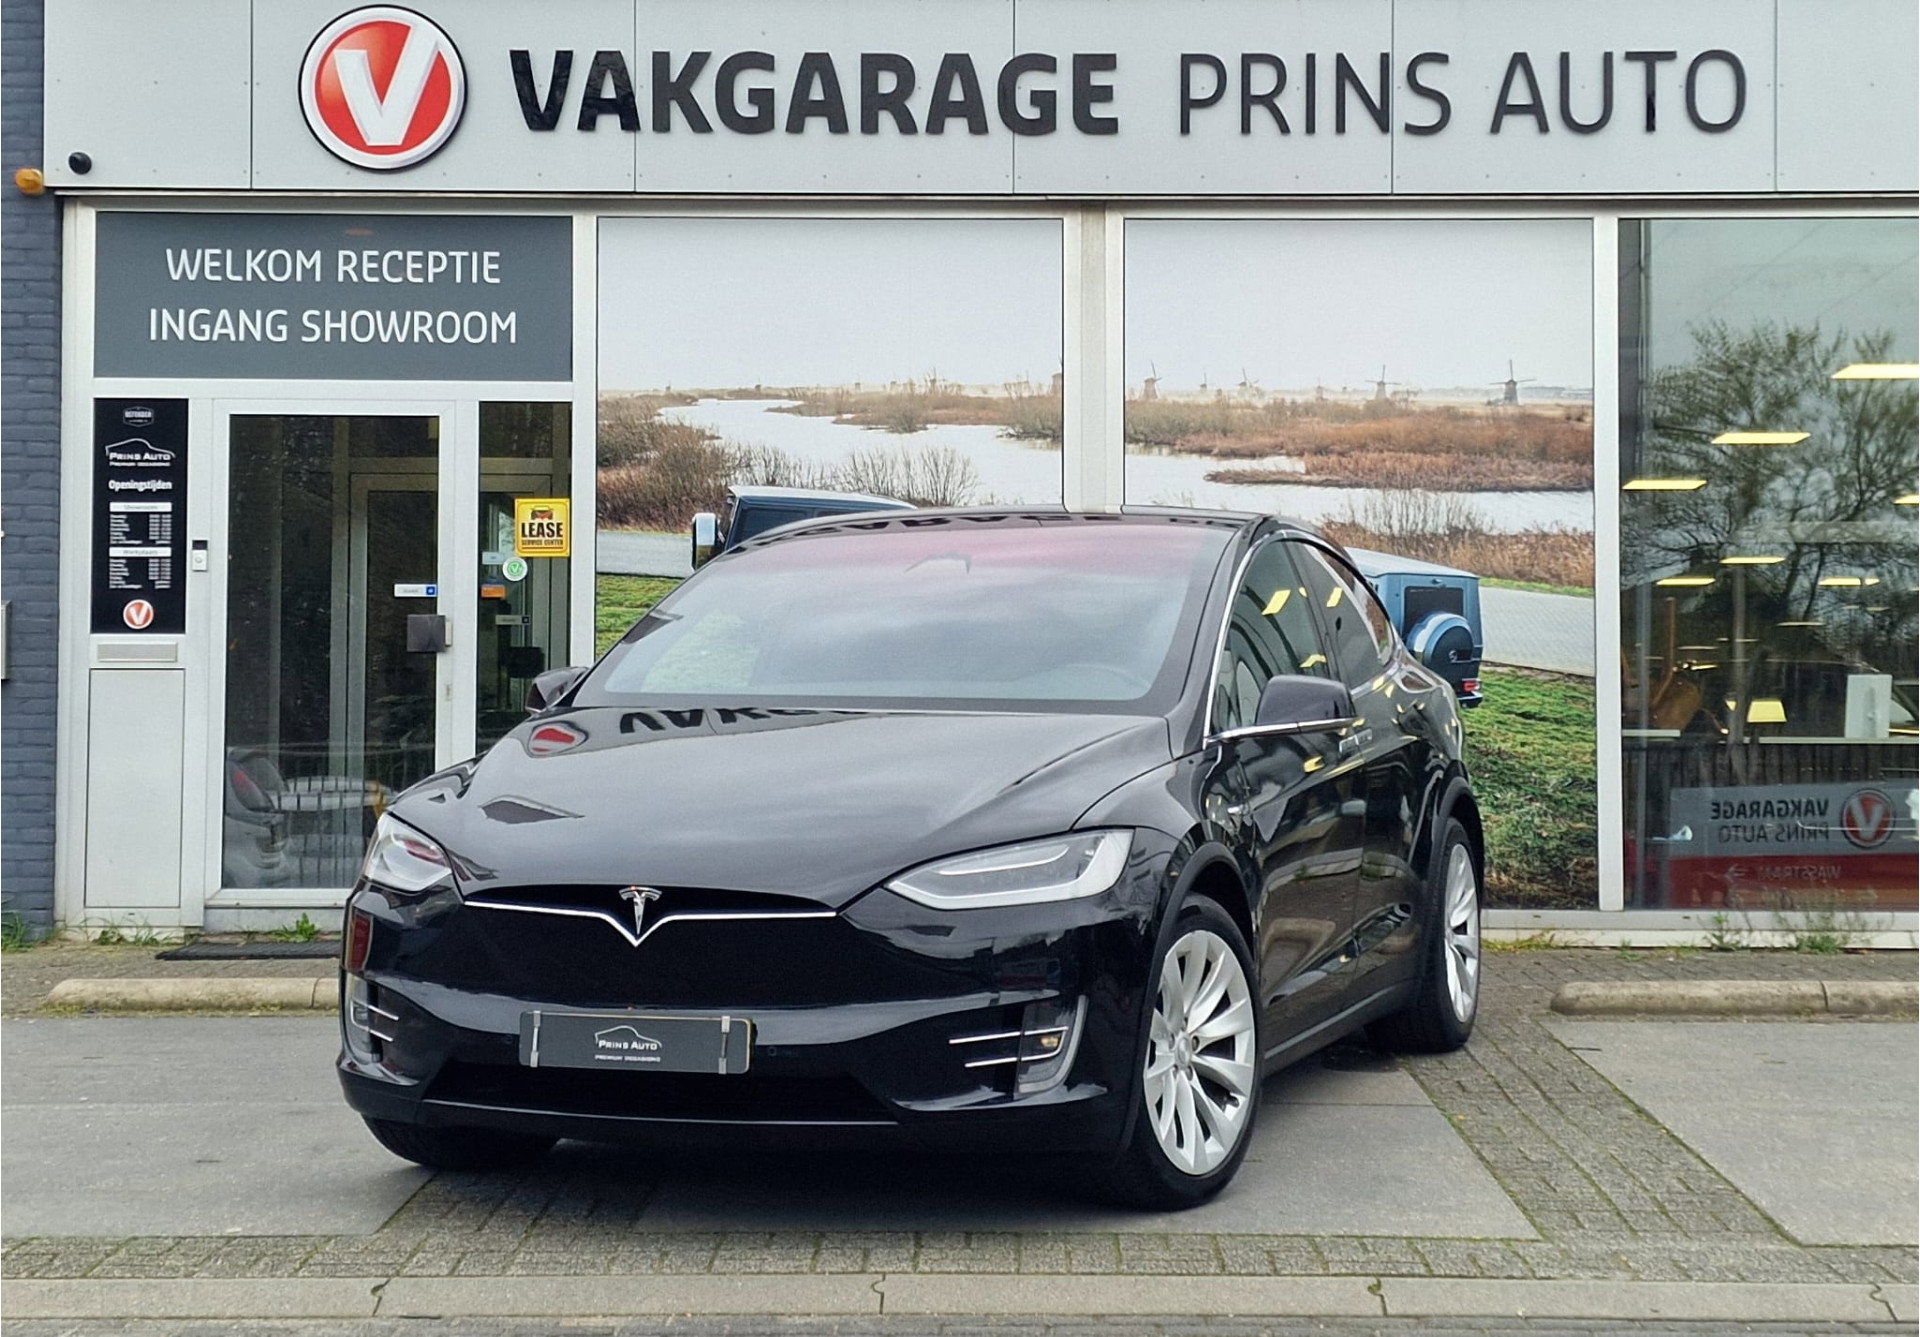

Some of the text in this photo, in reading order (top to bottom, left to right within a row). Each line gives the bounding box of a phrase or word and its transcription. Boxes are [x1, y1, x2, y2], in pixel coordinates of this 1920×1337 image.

[509, 50, 1747, 137] VAKGARAGE PRINS AUTO
[166, 248, 501, 284] WELKOM RECEPTIE
[150, 308, 517, 344] INGANG SHOWROOM
[143, 453, 171, 461] AUTO
[108, 479, 173, 492] Openingstijden
[521, 522, 564, 538] LEASE
[598, 1039, 658, 1051] PRINS AUTO
